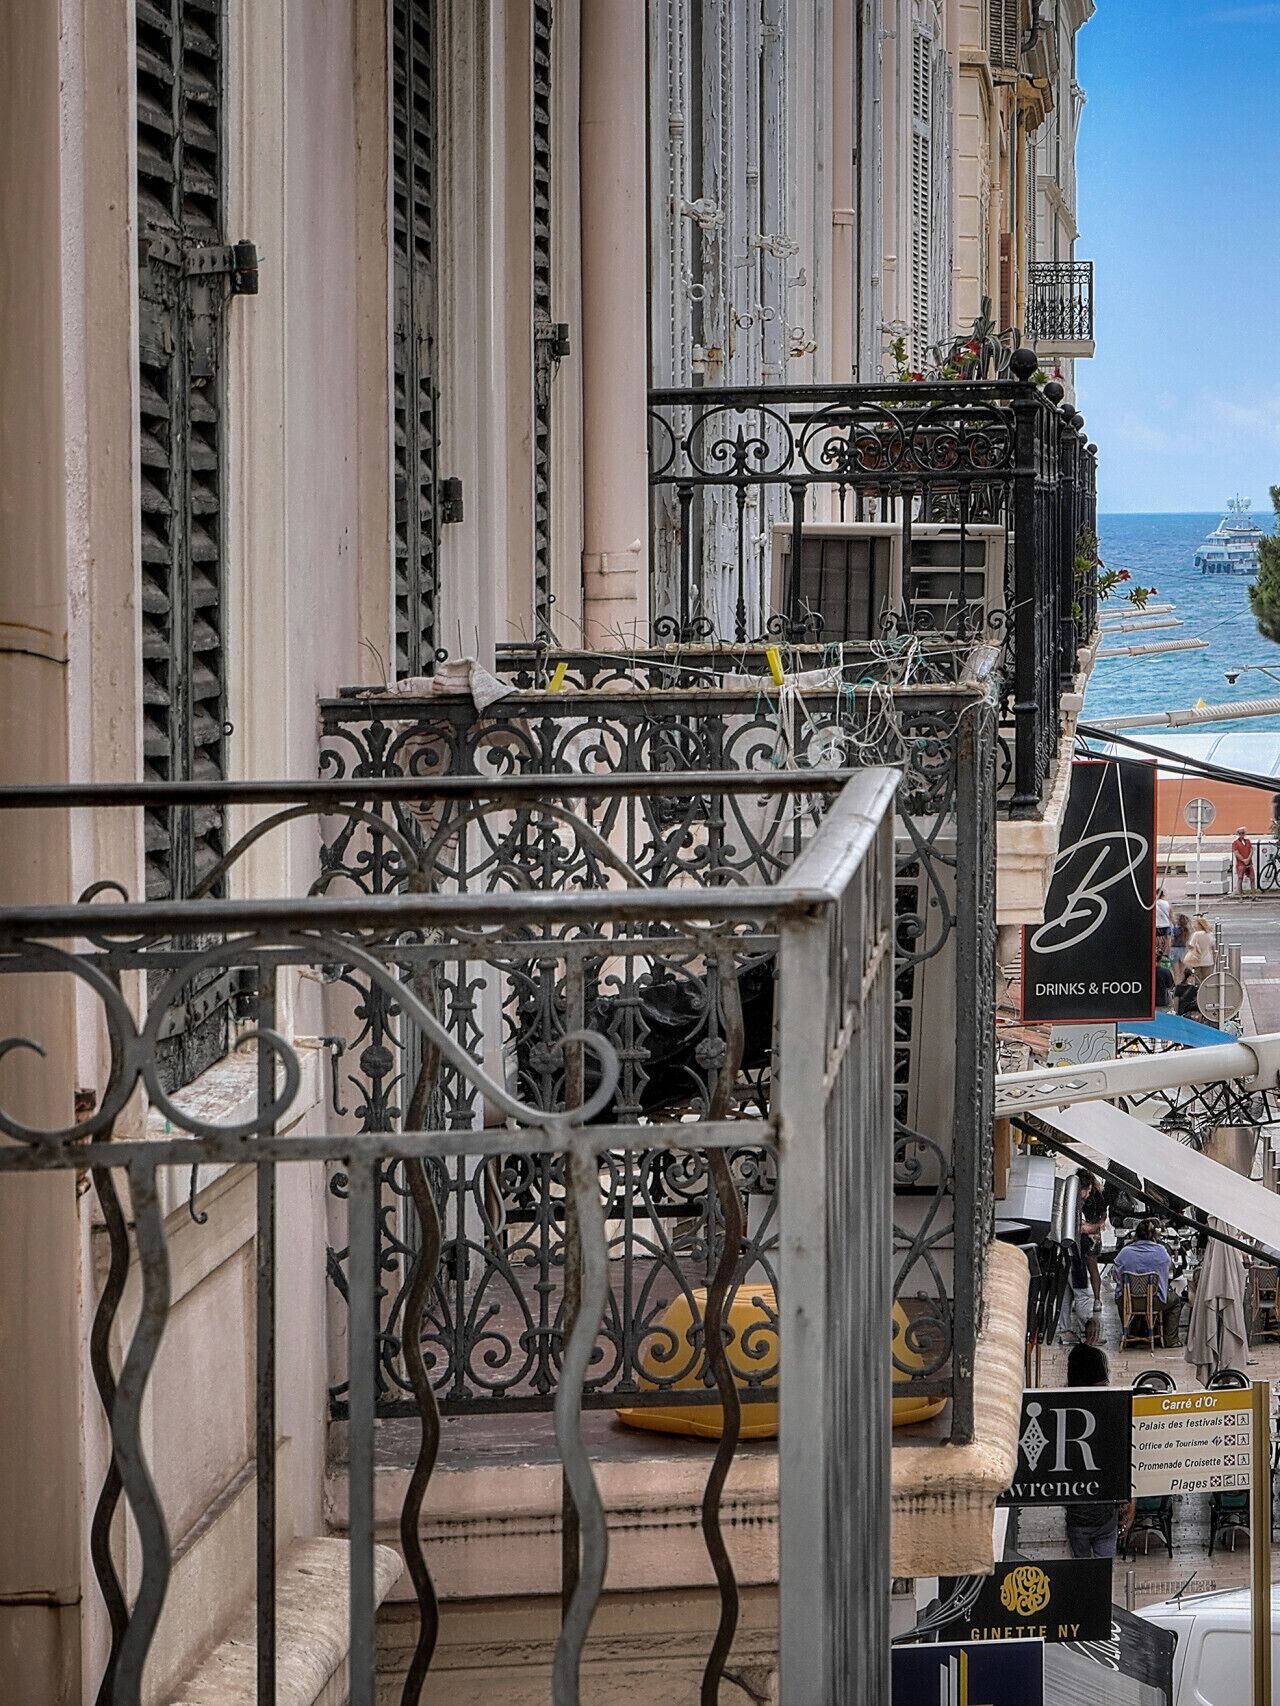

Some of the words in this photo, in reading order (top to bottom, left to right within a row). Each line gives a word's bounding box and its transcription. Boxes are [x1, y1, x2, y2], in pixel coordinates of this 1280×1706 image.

[1035, 982, 1085, 996] DRINKS
[1089, 982, 1099, 995] &
[1102, 981, 1142, 995] FOOD
[1162, 1397, 1192, 1410] Carré
[1195, 1396, 1218, 1408] d'Or
[1138, 1421, 1165, 1431] Palais
[1168, 1420, 1183, 1429] des
[1186, 1417, 1222, 1428] festivals
[1138, 1441, 1162, 1450] Office
[1164, 1440, 1174, 1449] de
[1176, 1440, 1209, 1448] Tourisme
[1138, 1460, 1182, 1471] Promenade
[1185, 1458, 1221, 1468] Croisette
[1170, 1479, 1208, 1492] Plages
[971, 1625, 1047, 1641] GINETTE
[1058, 1624, 1081, 1638] NY
